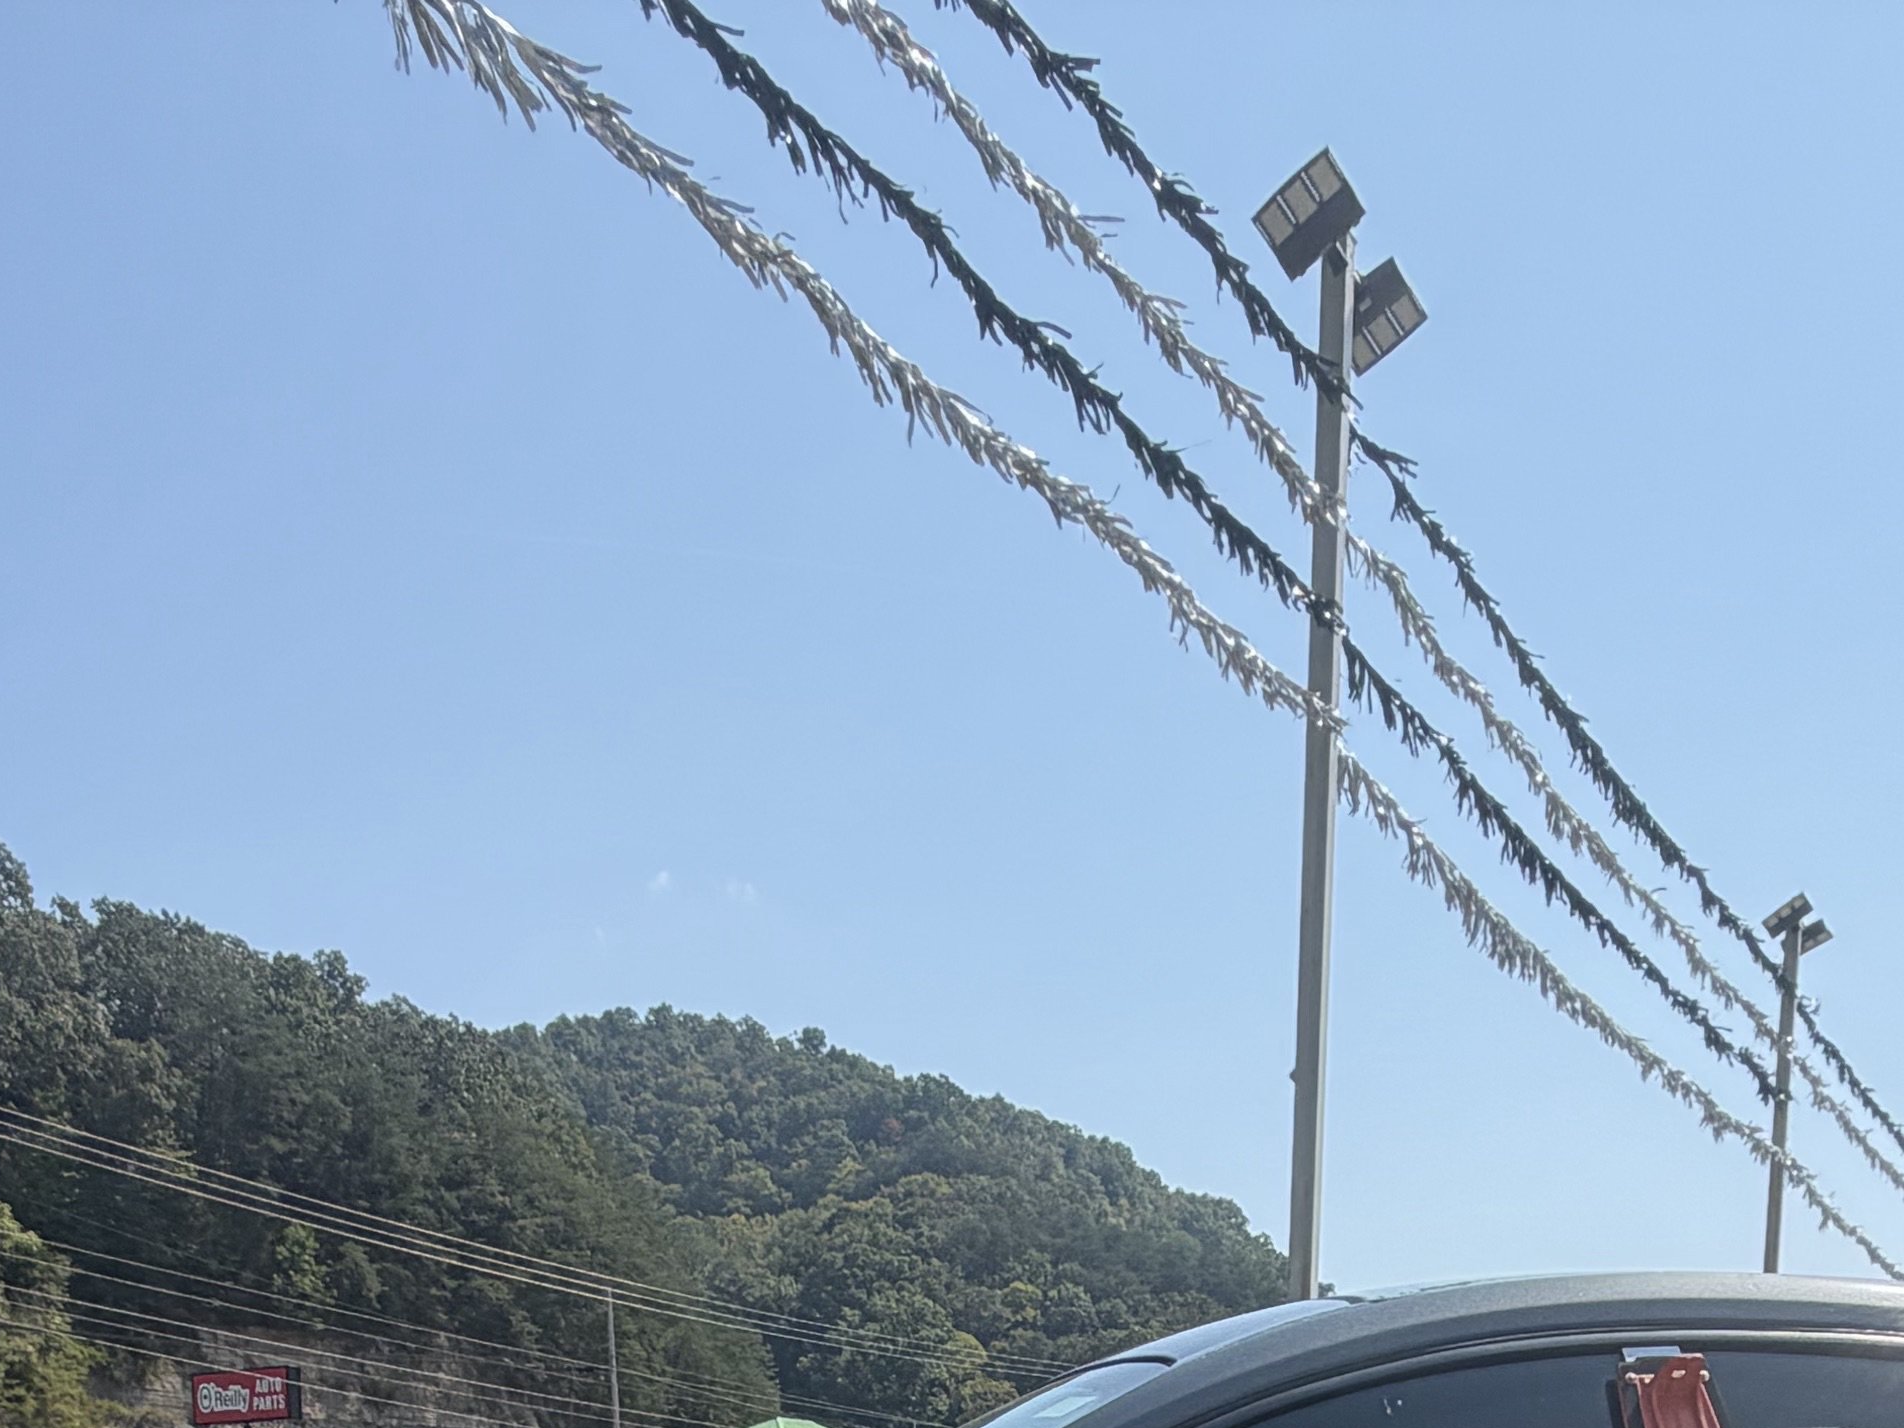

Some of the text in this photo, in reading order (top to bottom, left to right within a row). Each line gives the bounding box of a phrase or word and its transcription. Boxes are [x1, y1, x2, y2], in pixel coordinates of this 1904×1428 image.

[254, 1377, 283, 1394] AUTO
[198, 1382, 249, 1413] O'Reilly
[252, 1394, 286, 1411] PARTS
